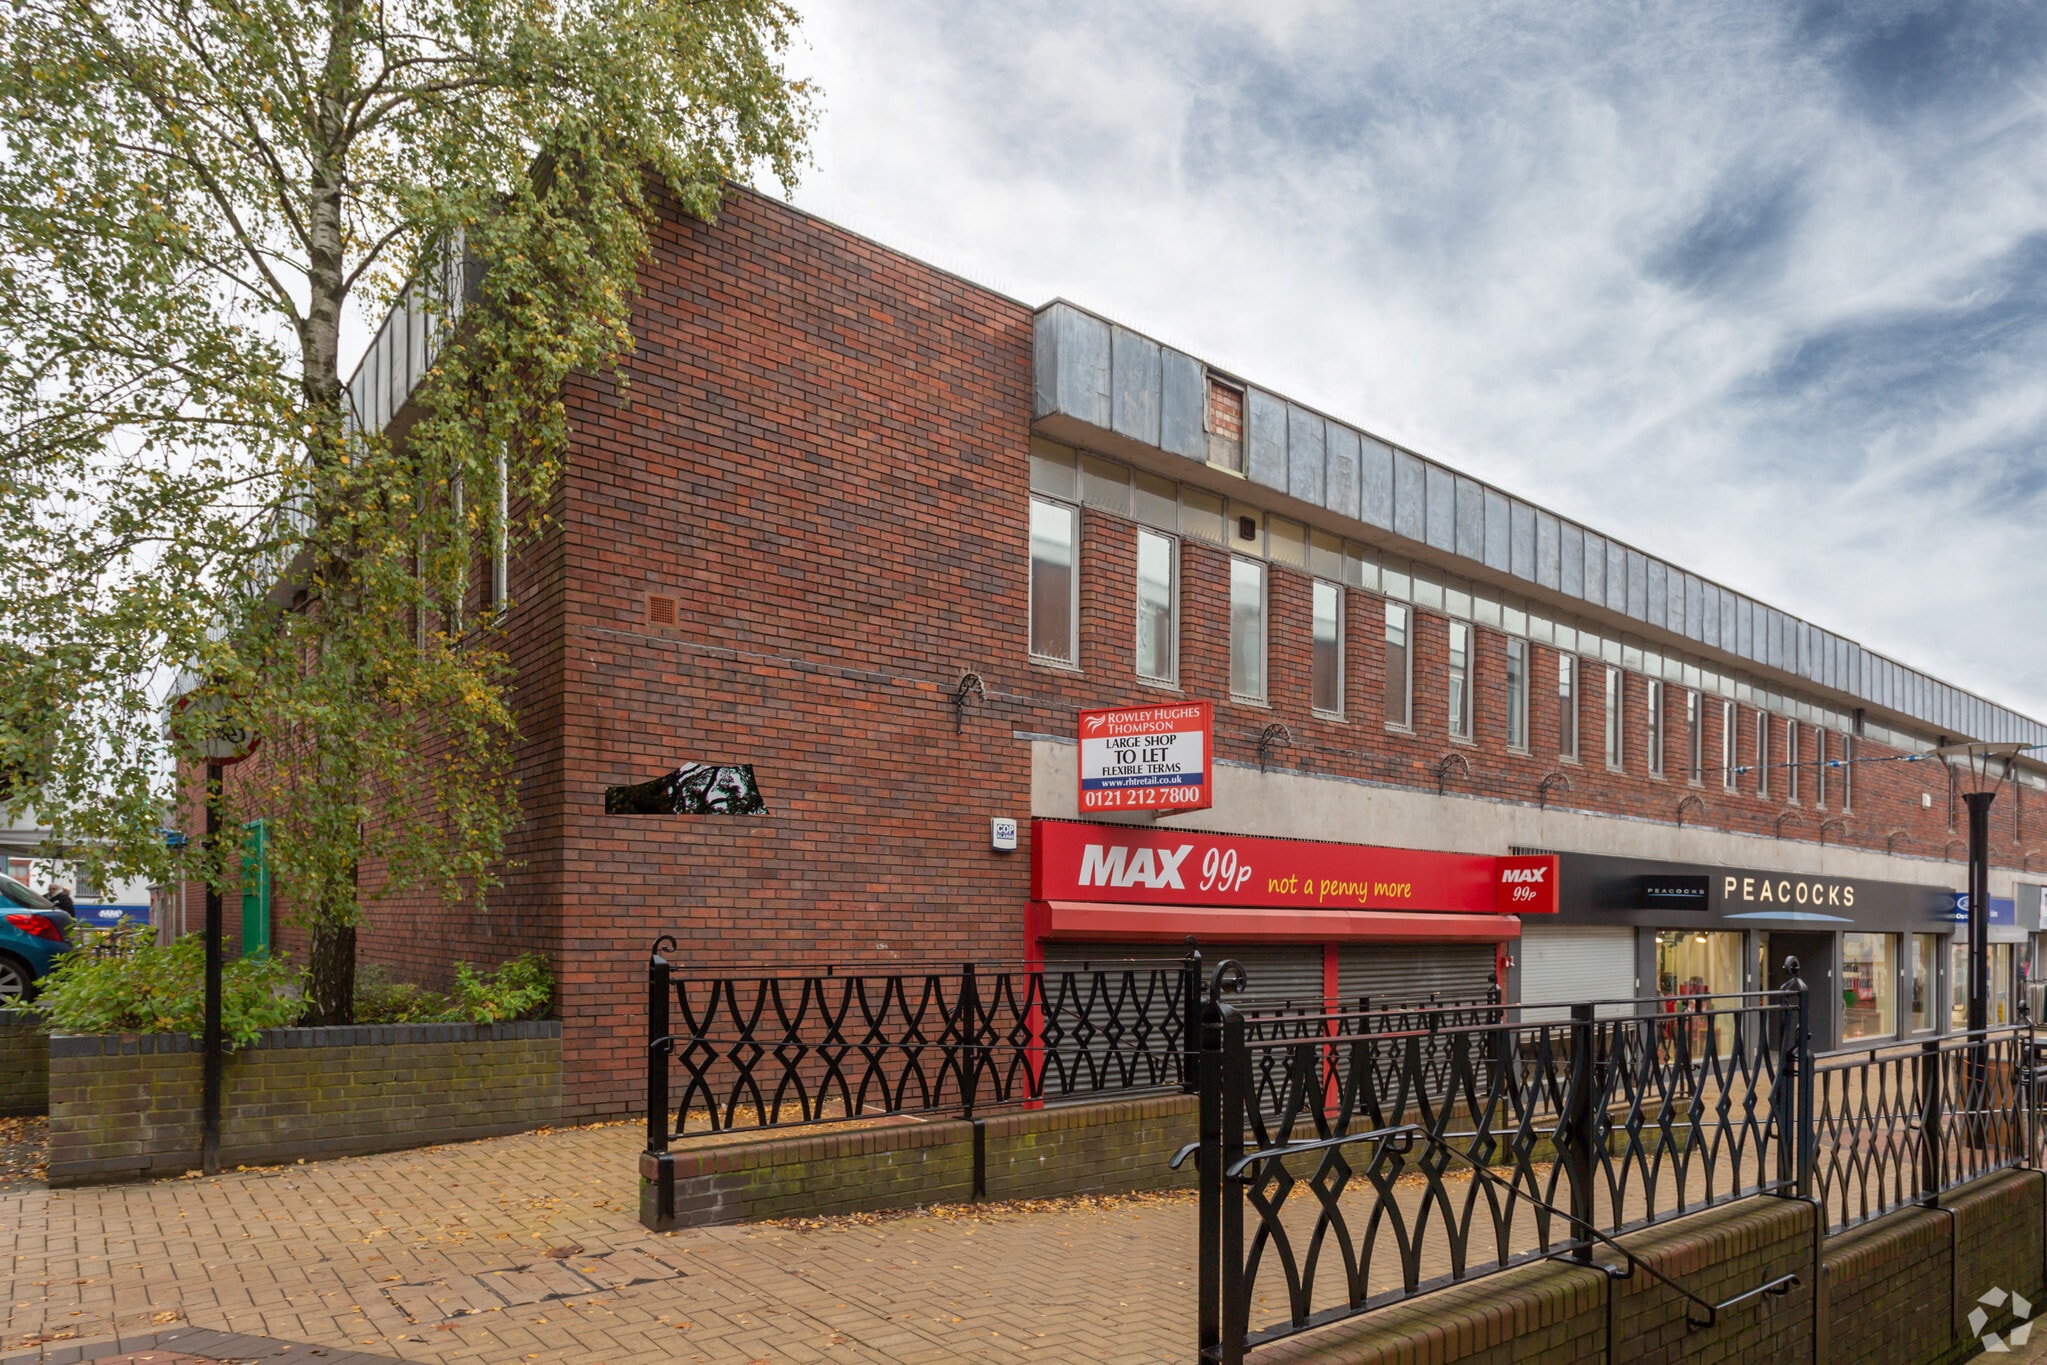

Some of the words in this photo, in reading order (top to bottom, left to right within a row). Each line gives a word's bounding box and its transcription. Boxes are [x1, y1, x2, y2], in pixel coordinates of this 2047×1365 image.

[1107, 711, 1152, 724] ROWLEY
[1154, 707, 1200, 720] HUGHES
[1107, 720, 1174, 735] THOMPSON
[1106, 736, 1141, 749] LARGE
[1144, 734, 1177, 747] SHOP
[1114, 749, 1137, 764] TO
[1142, 747, 1169, 763] LET
[1102, 764, 1143, 776] FLEXIBLE
[1146, 762, 1181, 774] TERMS
[1101, 775, 1182, 788] www.rhtretail.co.uk
[1085, 790, 1121, 807] 0121
[1126, 788, 1156, 805] 212
[1160, 786, 1200, 804] 7800
[997, 824, 1014, 834] COP
[1078, 843, 1194, 890] MAX
[1200, 847, 1252, 892] 99p
[1501, 866, 1548, 883] MAX
[1268, 873, 1298, 895] not
[1303, 879, 1314, 895] a
[1319, 879, 1368, 903] penny
[1374, 881, 1412, 898] more
[1647, 887, 1705, 895] PEACOCKS
[1724, 876, 1855, 907] PEACOCKS
